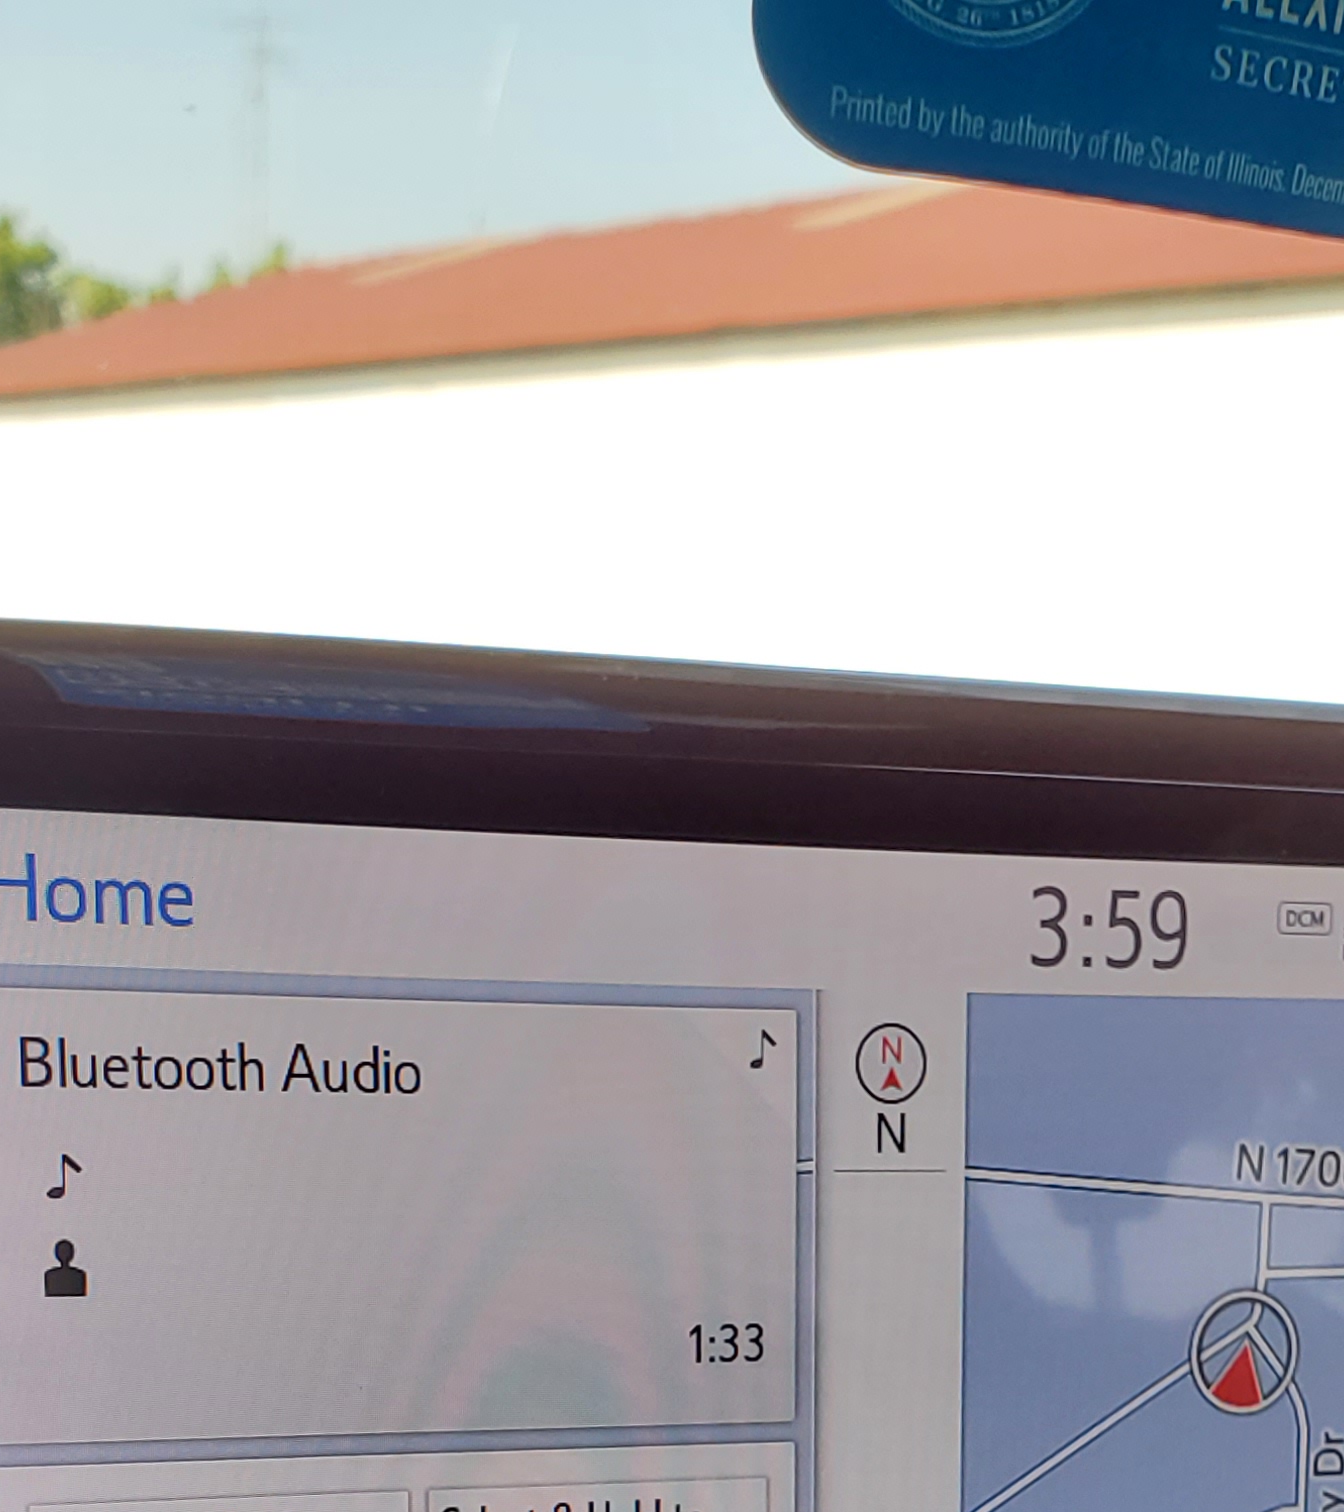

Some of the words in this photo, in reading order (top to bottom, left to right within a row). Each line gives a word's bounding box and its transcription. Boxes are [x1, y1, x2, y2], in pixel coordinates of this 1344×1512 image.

[831, 85, 911, 128] Printed
[918, 98, 944, 138] by
[951, 104, 985, 140] the
[991, 114, 1084, 161] authority
[1087, 129, 1109, 160] of
[1114, 131, 1145, 167] the
[1149, 135, 1200, 177] State
[1204, 150, 1225, 180] of
[1029, 885, 1189, 970] 3:59
[1286, 908, 1325, 929] DCM
[18, 1036, 265, 1092] Bluetooth
[281, 1043, 423, 1095] Audio
[881, 1036, 902, 1065] N
[876, 1114, 906, 1154] N
[1235, 1143, 1265, 1184] N
[688, 1324, 766, 1365] 1:33
